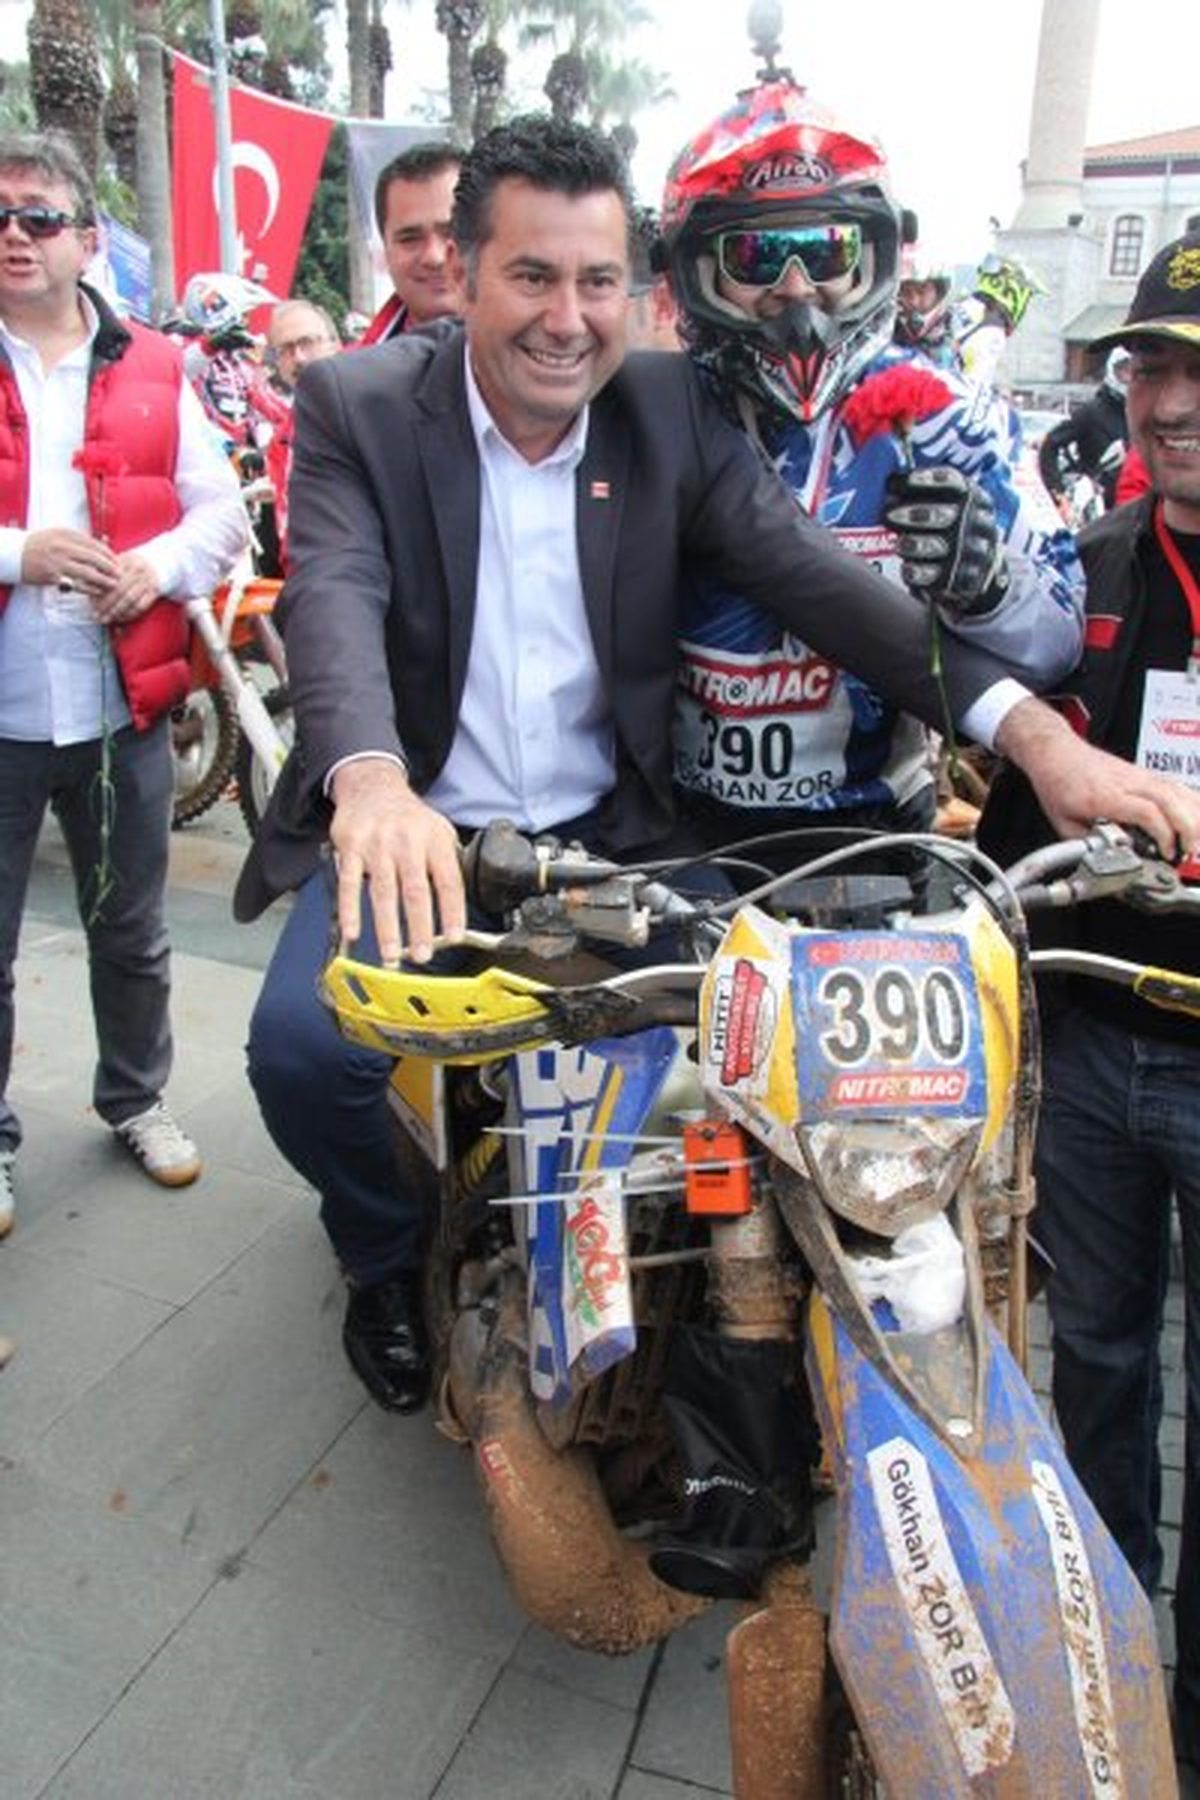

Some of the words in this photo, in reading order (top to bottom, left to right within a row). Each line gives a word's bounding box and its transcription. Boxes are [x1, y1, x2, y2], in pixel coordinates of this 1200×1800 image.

[776, 770, 834, 802] ZOR
[819, 966, 968, 1065] 390
[886, 1458, 930, 1573] Gökhan
[920, 1576, 965, 1655] ZOR
